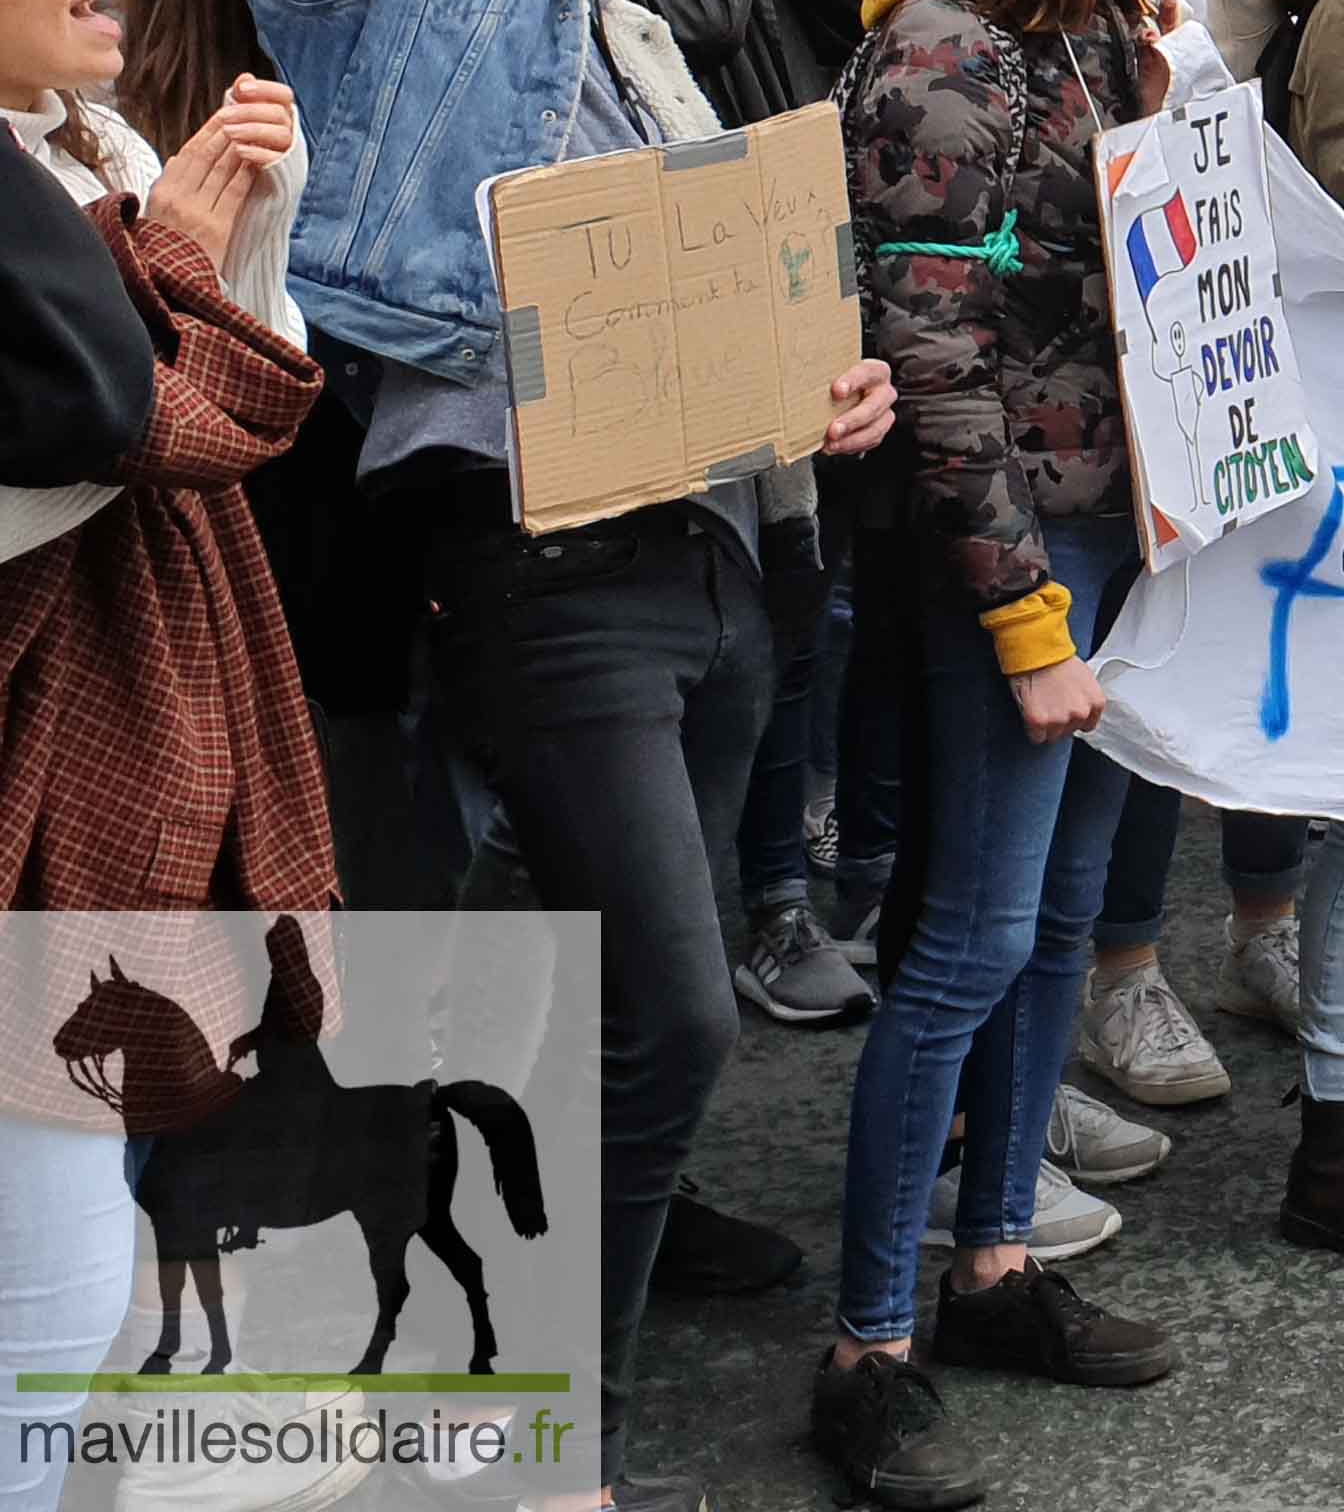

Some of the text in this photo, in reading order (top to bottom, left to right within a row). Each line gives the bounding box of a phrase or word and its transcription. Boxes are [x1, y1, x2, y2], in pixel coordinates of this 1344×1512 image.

[1190, 111, 1231, 174] JE
[1198, 255, 1251, 323] MON
[1228, 398, 1259, 450] DE
[1213, 432, 1315, 516] CITOYEN
